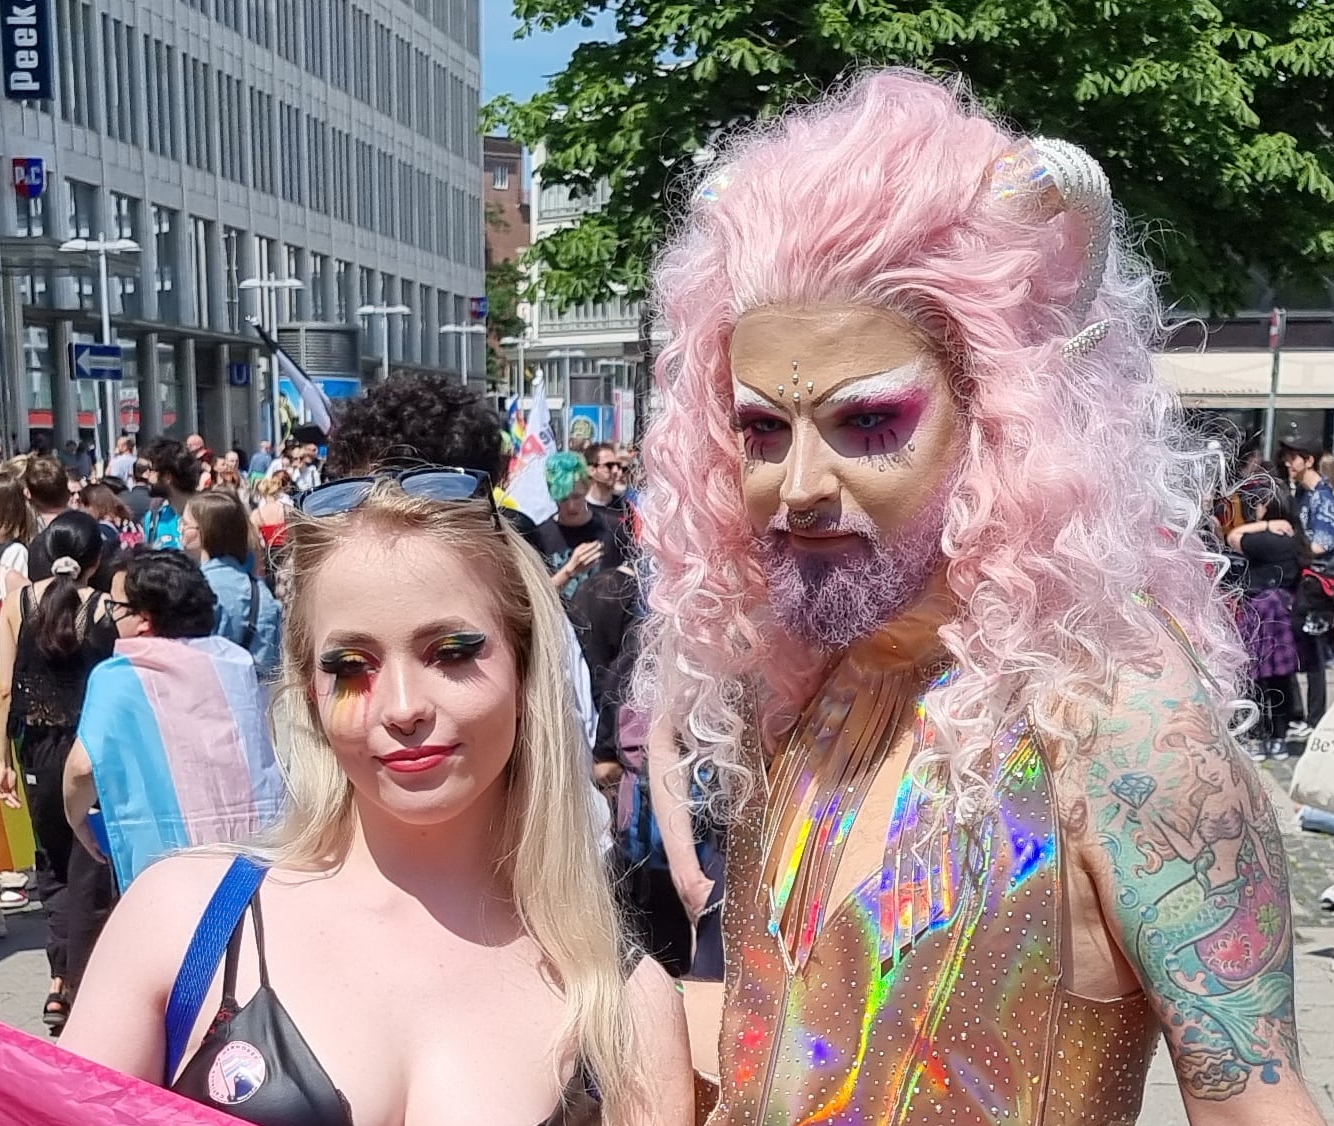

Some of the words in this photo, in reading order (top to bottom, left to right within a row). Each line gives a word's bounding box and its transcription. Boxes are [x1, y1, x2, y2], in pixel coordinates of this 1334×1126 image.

[6, 5, 40, 91] Peek
[14, 165, 42, 186] P&C
[1310, 737, 1330, 752] Be
